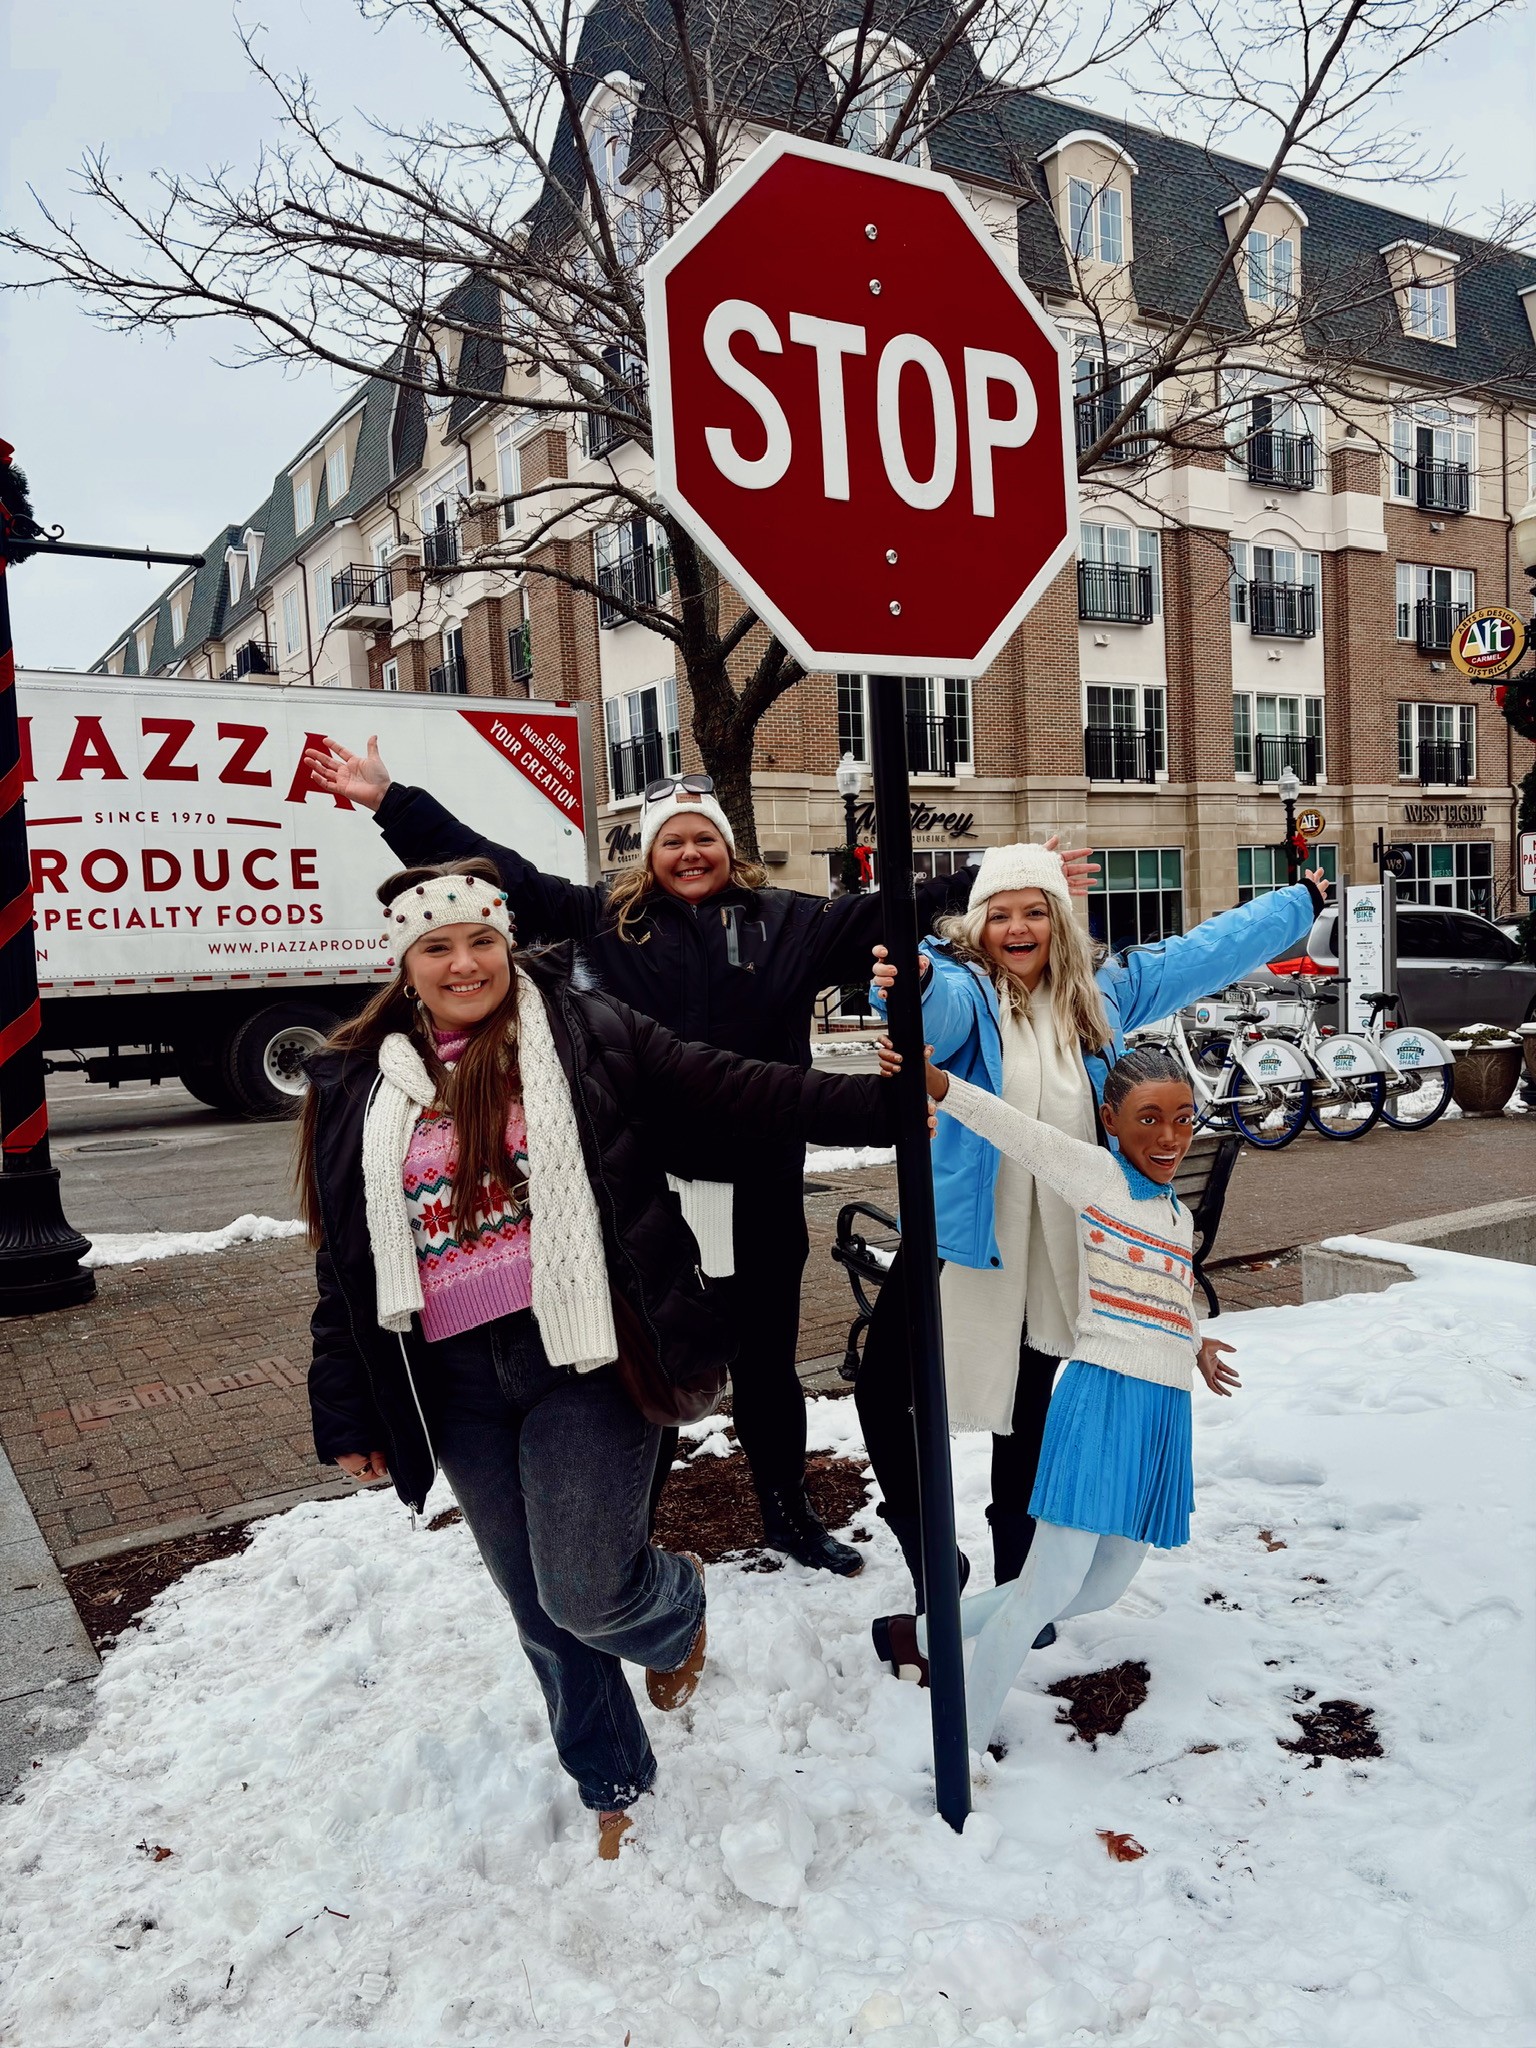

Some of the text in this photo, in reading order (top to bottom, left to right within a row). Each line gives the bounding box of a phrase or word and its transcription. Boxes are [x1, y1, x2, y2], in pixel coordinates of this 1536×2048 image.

[703, 299, 1038, 517] STOP
[1458, 615, 1477, 634] ARTS
[1487, 609, 1517, 625] DESIGN
[1462, 618, 1511, 658] Art
[1467, 660, 1508, 676] DISTRICT
[1471, 653, 1502, 664] CARMEL
[490, 719, 522, 756] YOUR
[546, 732, 567, 755] OUR
[17, 716, 356, 811] IAZZA
[520, 723, 575, 783] INGREDIENTS,
[95, 811, 216, 825] SINCE 1970
[1404, 805, 1487, 822] WEST EIGHT
[29, 848, 319, 893] RODUCE
[217, 904, 323, 926] FOODS
[208, 939, 388, 955] WWW.PIAZZAPRODUC
[1400, 1052, 1420, 1060] BIKE
